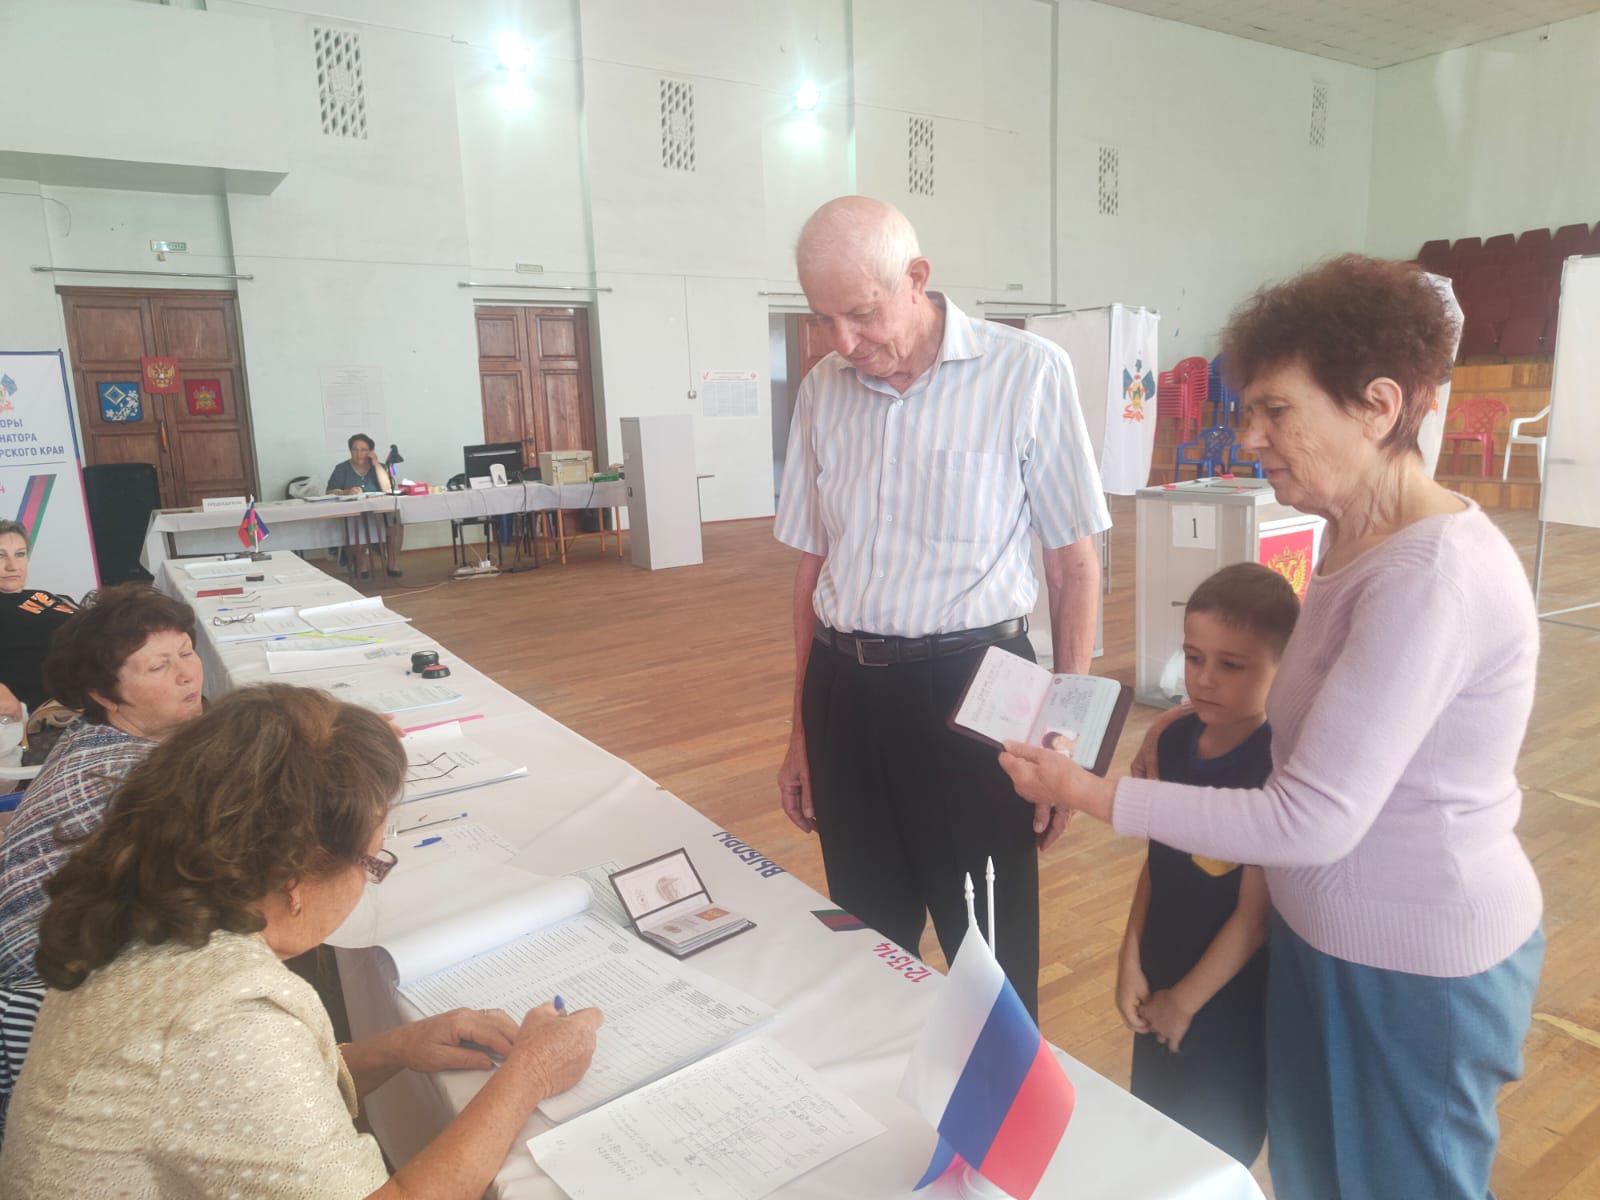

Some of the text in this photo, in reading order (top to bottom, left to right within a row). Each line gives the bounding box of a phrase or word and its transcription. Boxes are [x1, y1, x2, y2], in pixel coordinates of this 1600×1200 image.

[40, 446, 64, 456] КРАЯ
[1191, 517, 1199, 539] 1
[711, 831, 788, 879] ВЫБОРЫ
